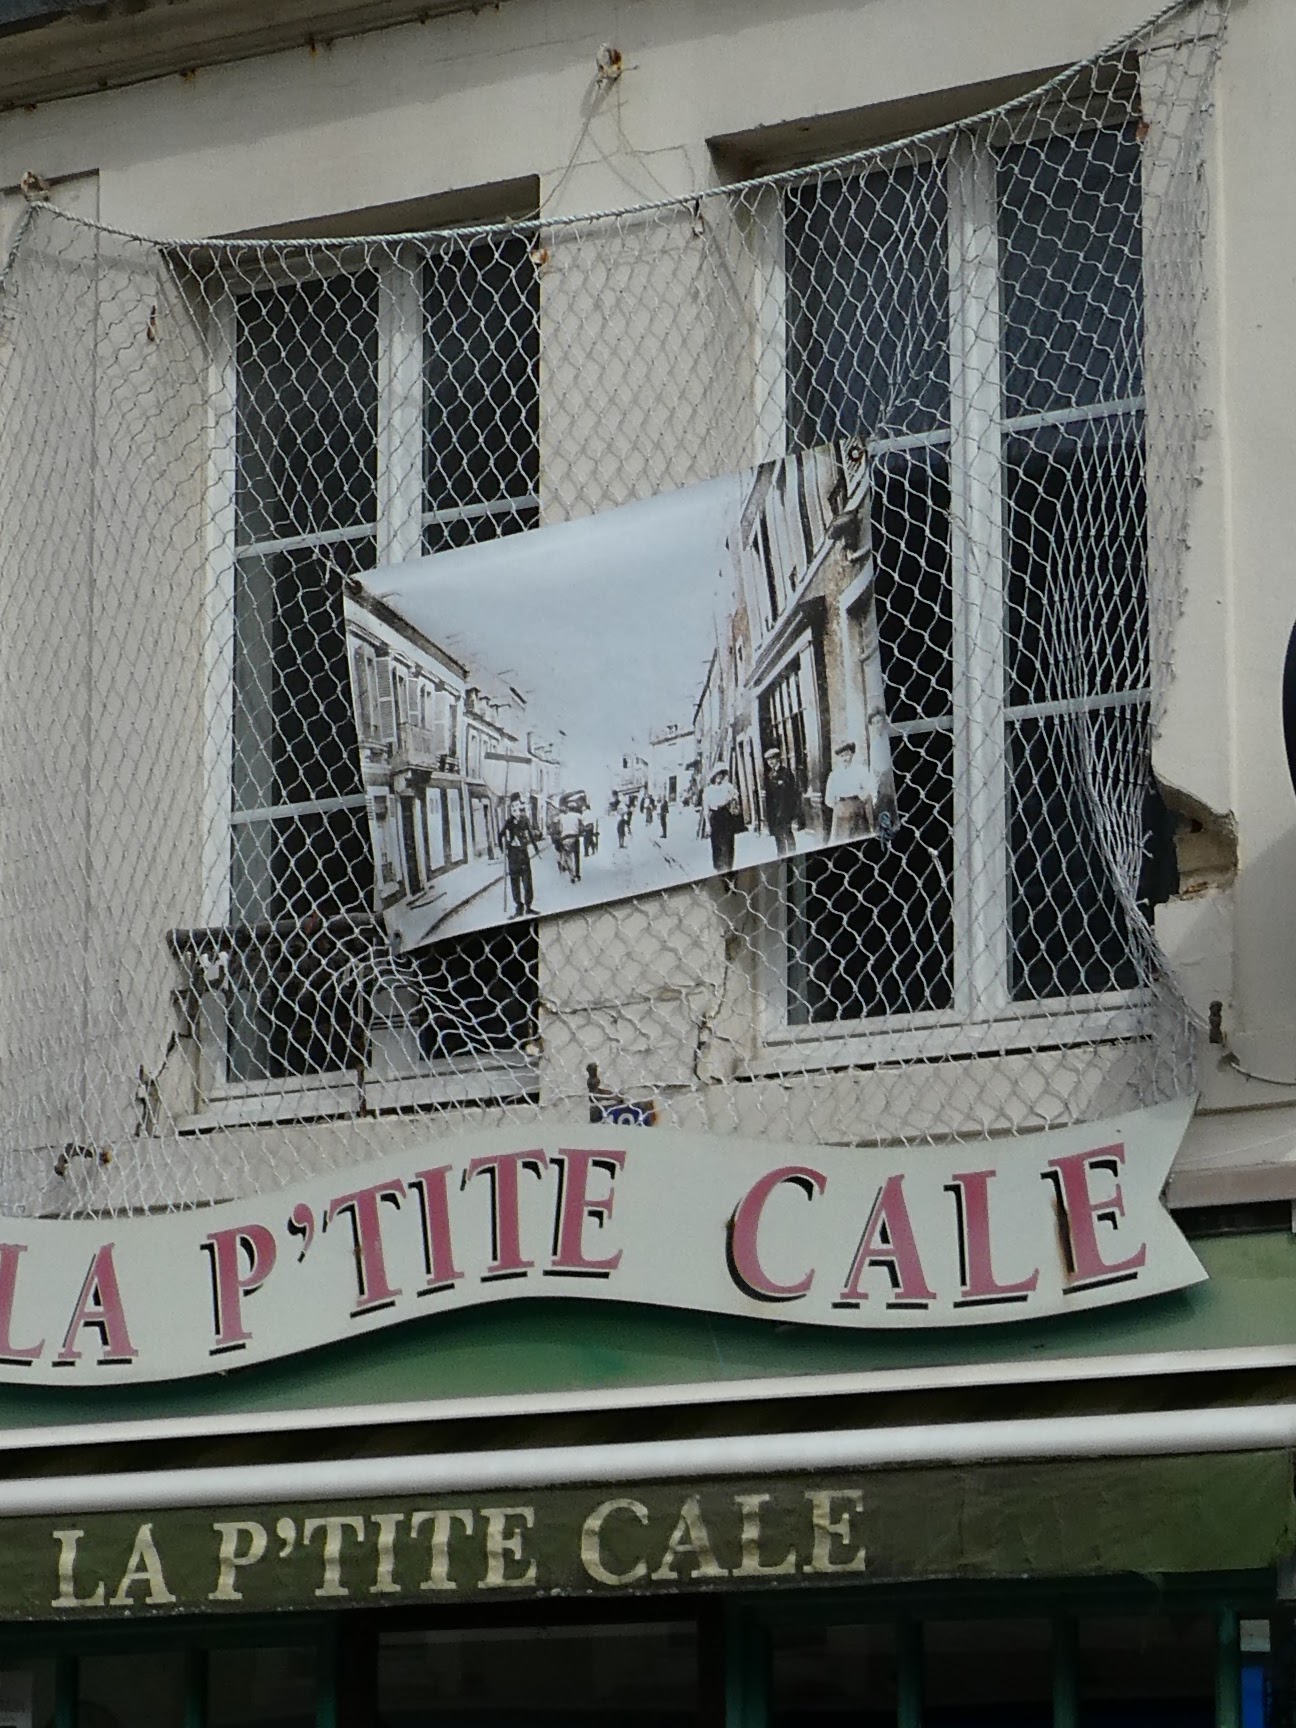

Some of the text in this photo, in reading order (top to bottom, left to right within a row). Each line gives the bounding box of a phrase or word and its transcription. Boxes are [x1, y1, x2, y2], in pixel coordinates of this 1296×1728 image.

[200, 1150, 626, 1356] P'TITE
[725, 1142, 1147, 1309] CALE
[50, 1489, 867, 1608] LA P'TITE CALE
